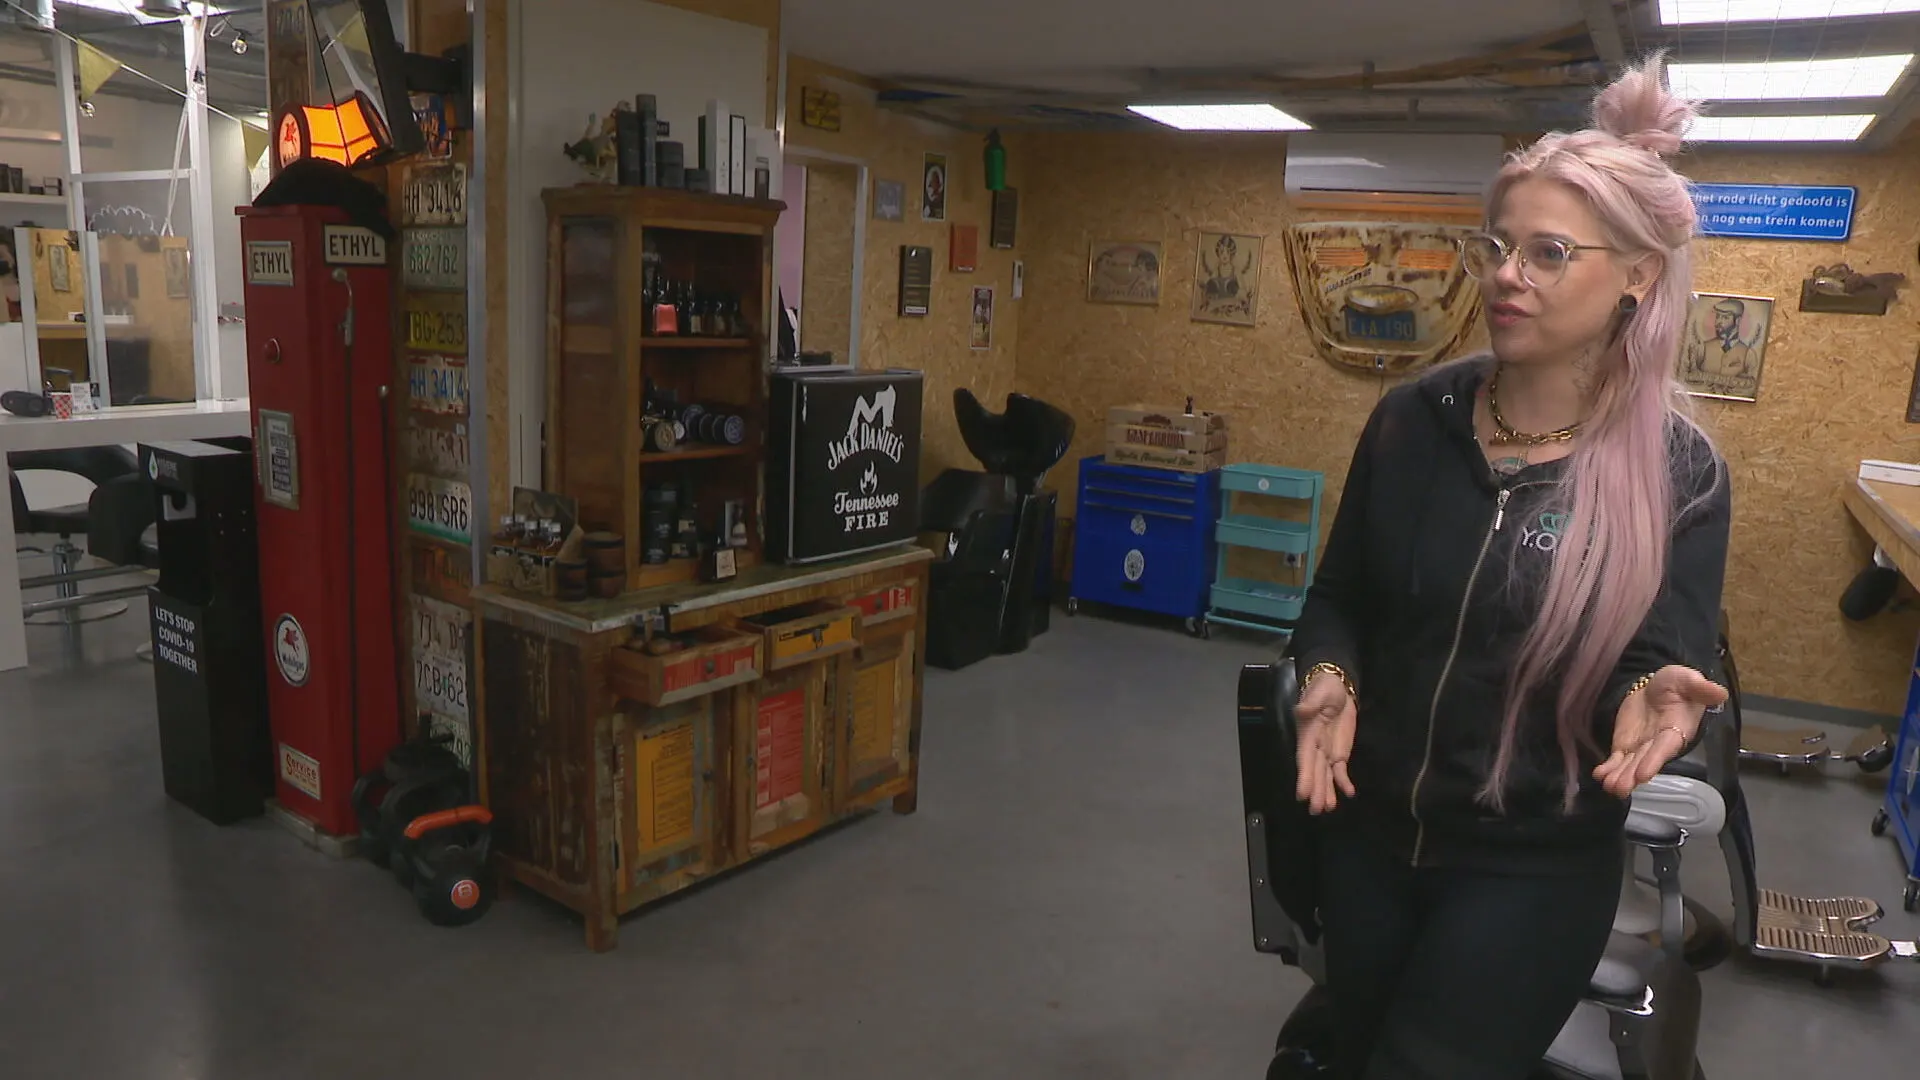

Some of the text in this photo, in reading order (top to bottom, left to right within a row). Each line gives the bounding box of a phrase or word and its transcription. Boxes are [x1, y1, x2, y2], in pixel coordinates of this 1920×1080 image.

[428, 181, 462, 215] 3416
[1695, 193, 1848, 208] het rode licht gedoofd is
[1711, 214, 1736, 226] nog
[1739, 215, 1762, 225] een
[1765, 214, 1797, 226] trein
[1800, 216, 1845, 228] komen
[330, 234, 381, 257] ETHYL
[252, 252, 290, 274] ETHYL
[431, 368, 466, 402] 3414
[828, 421, 905, 470] JACK DANIEL'S
[409, 488, 468, 531] 898 SR6
[834, 490, 900, 515] Tennessee
[844, 510, 889, 532] FIRE
[154, 605, 195, 634] LET'S STOP
[158, 626, 195, 653] COVID-19
[158, 643, 199, 673] TOGETHER
[286, 752, 317, 780] Service
